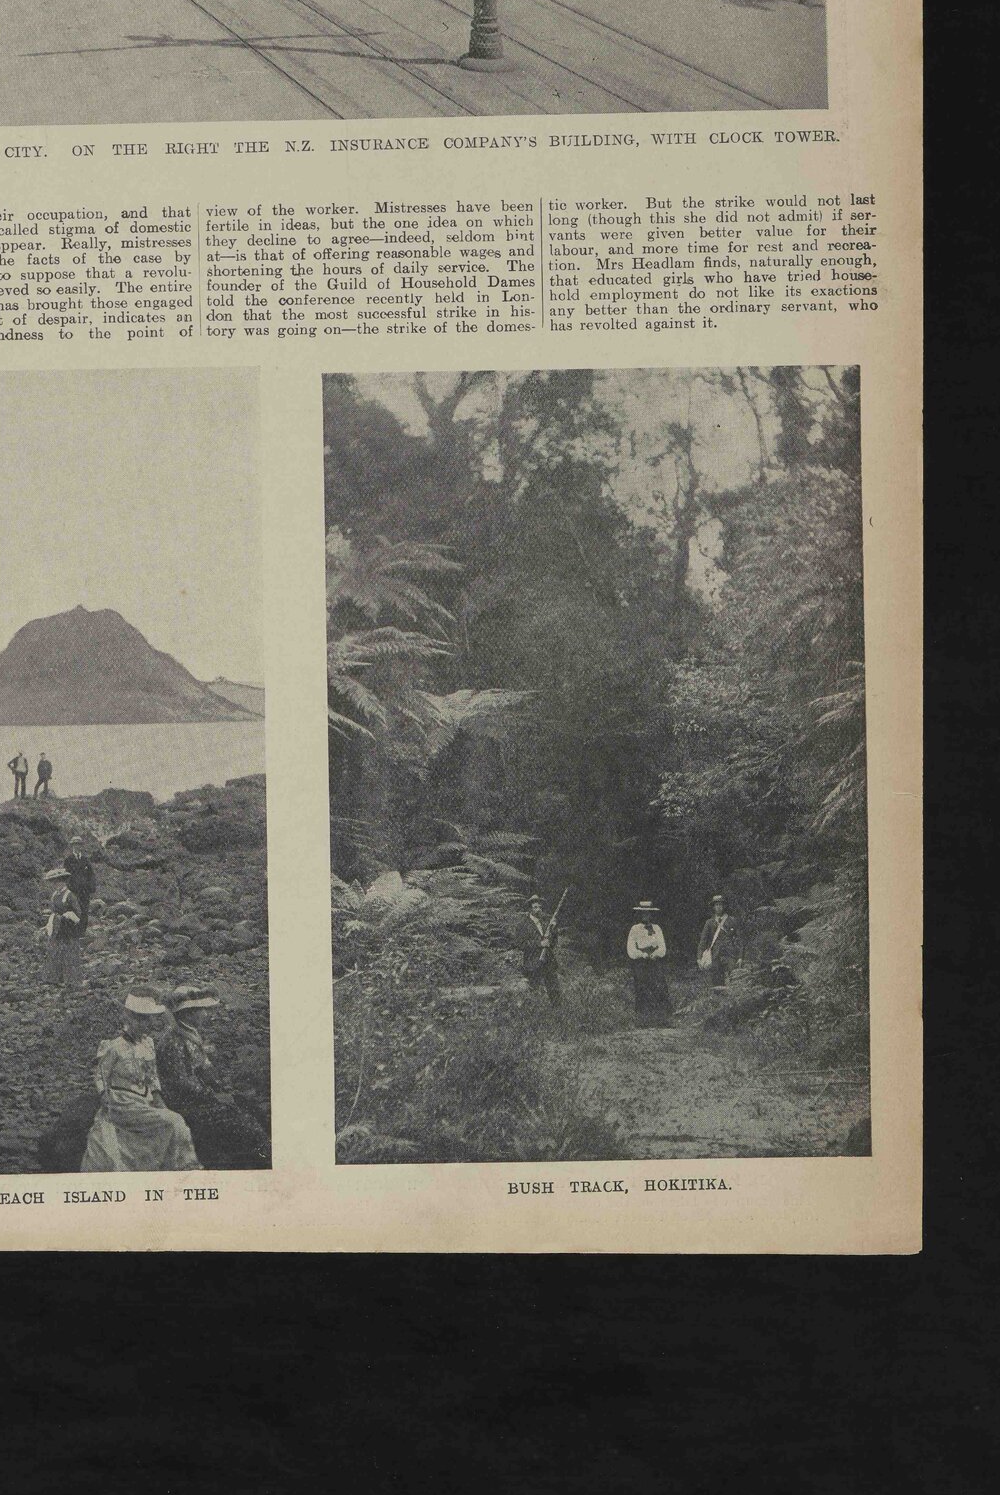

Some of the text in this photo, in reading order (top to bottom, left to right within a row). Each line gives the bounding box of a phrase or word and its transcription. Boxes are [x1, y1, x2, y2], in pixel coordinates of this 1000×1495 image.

[4, 145, 48, 159] CITY.
[71, 144, 96, 157] ON
[111, 143, 148, 156] THE
[164, 142, 220, 155] RIGHT
[233, 140, 270, 154] THE
[284, 139, 315, 153] N.Z.
[329, 137, 430, 152] INSURANCE
[548, 133, 640, 148] BUILDING,
[650, 132, 697, 145] WITH
[708, 131, 765, 145] CLOCK
[773, 129, 841, 144] TOWER.
[205, 199, 534, 217] view of the worker. Mistresses have been
[48, 223, 97, 238] stigma
[104, 220, 120, 235] of
[129, 220, 192, 234] domestic
[548, 222, 878, 243] vants were given better value for their
[60, 236, 112, 253] Really,
[120, 235, 192, 249] mistresses
[206, 274, 536, 293] founder of the Guild of Household Dames
[205, 304, 536, 322] don that the most successful strike in his-
[549, 298, 879, 320] any better than the ordinary servant, who
[58, 328, 74, 340] to
[88, 326, 112, 340] the
[126, 325, 165, 342] point
[178, 324, 194, 338] of
[549, 315, 718, 333] has revolted against it.
[507, 1177, 733, 1195] BUSH TRACK, HOKITIKA.
[62, 1190, 127, 1204] ISLAND
[144, 1189, 165, 1202] IN
[182, 1187, 220, 1201] THE
